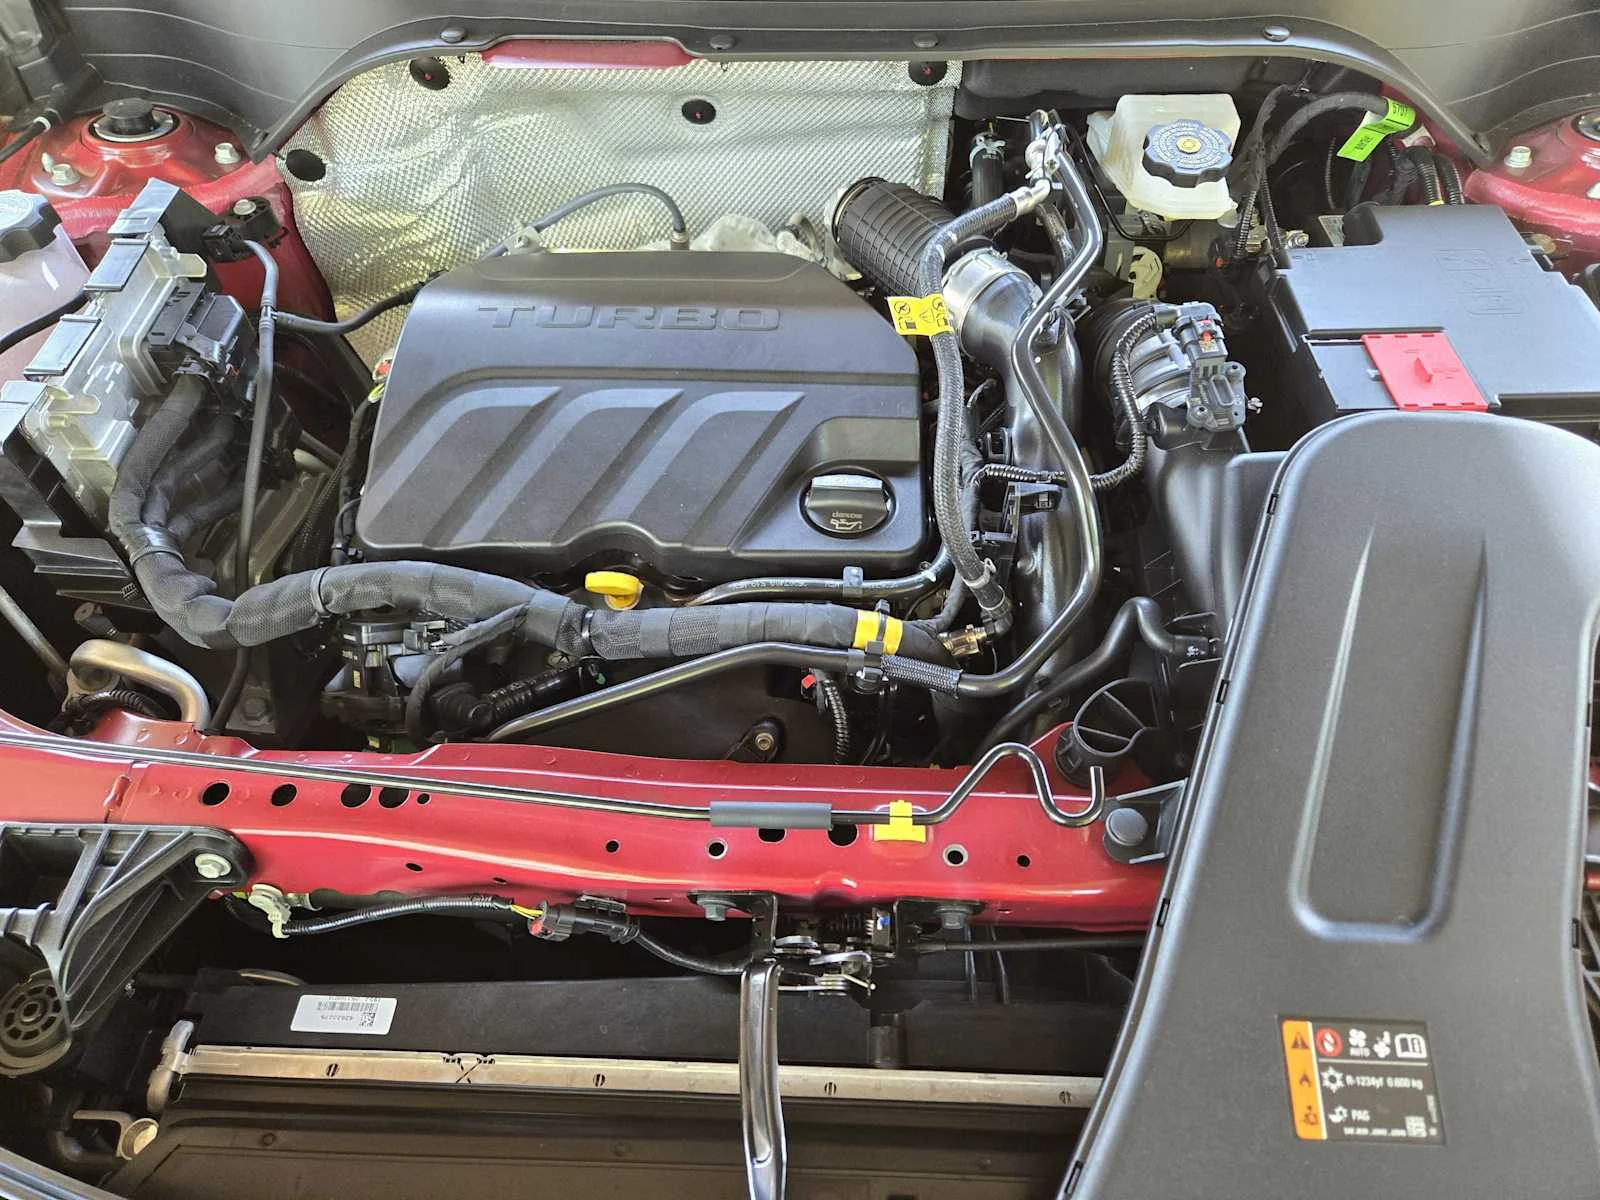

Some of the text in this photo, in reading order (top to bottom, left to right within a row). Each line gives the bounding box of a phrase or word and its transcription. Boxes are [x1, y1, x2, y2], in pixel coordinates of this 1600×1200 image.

[478, 304, 780, 331] TURBO
[1411, 1078, 1424, 1091] kg
[1351, 1109, 1370, 1122] PAG
